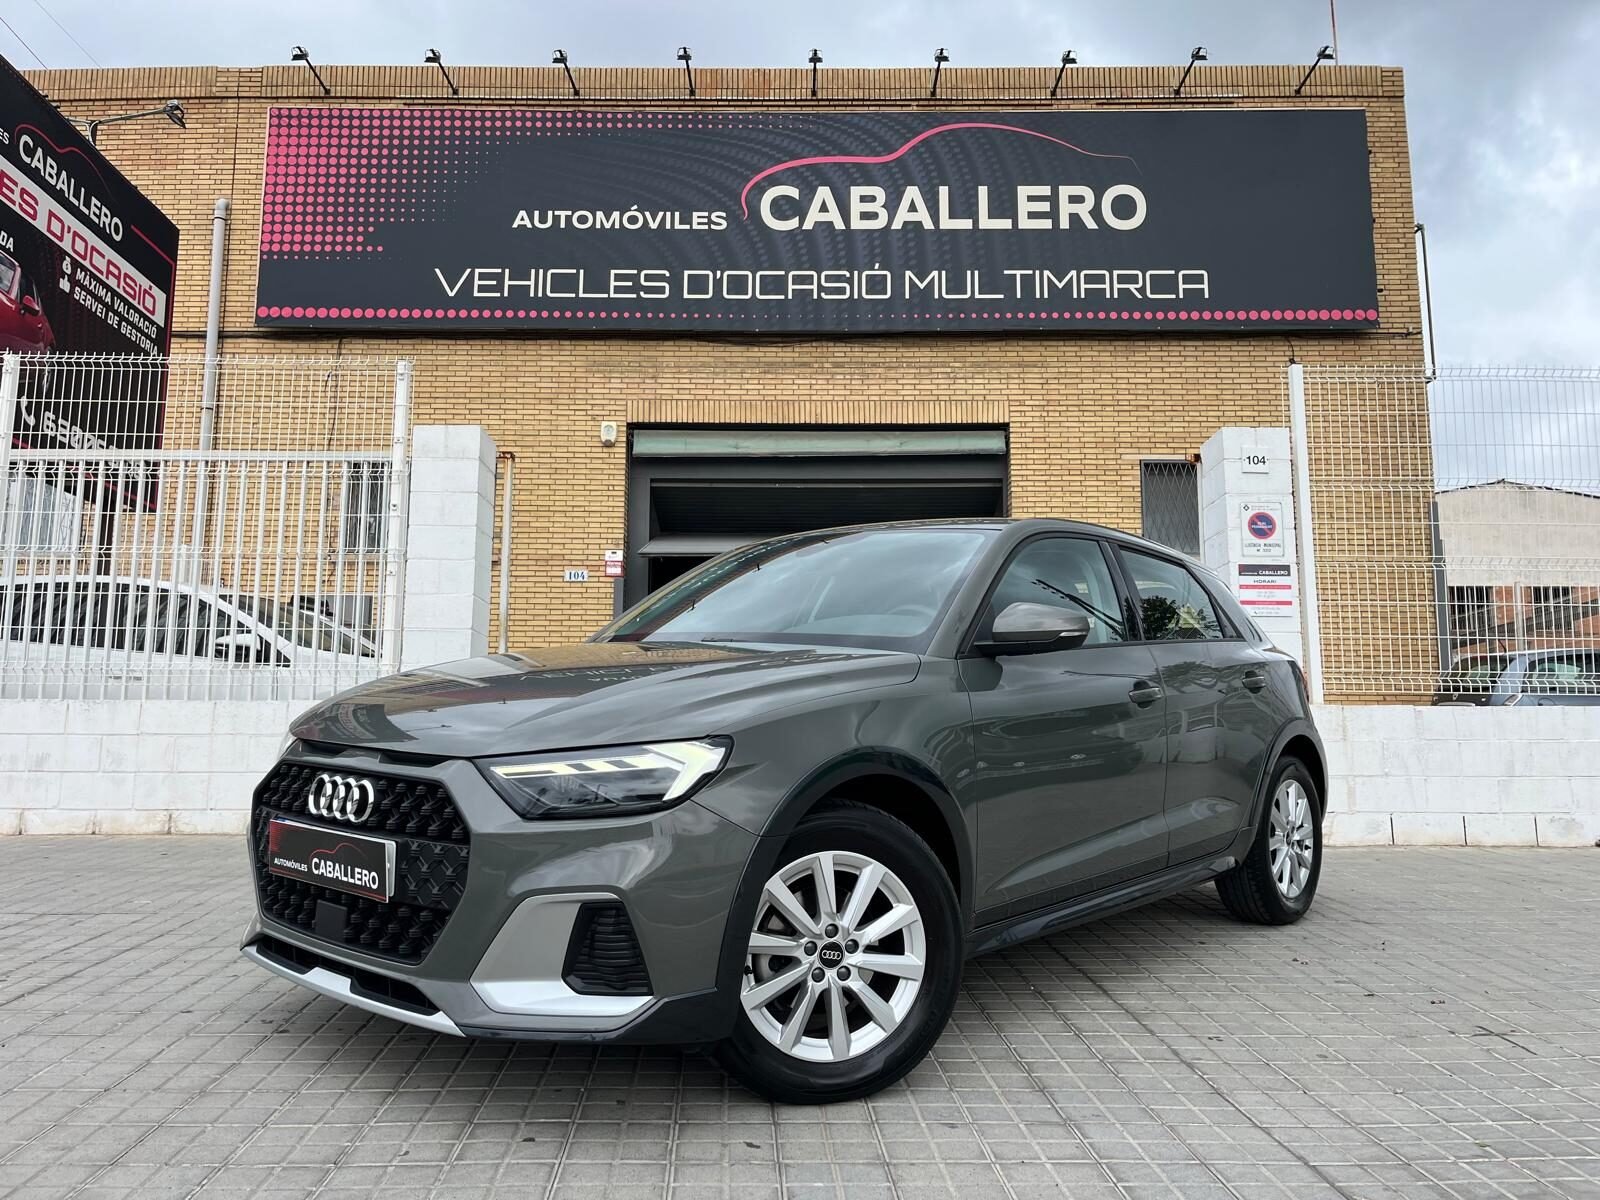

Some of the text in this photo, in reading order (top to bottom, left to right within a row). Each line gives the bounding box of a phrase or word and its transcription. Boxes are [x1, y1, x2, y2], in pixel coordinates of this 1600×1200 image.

[19, 134, 123, 242] CABALLERO
[512, 184, 1147, 231] AUTOMÓVILES CABALLERO
[47, 208, 157, 317] D'OCASIÓ
[434, 262, 1210, 300] VEHICLES D'OCASIÓ MULTIMARCA
[73, 286, 106, 320] SERVEI
[107, 311, 120, 329] DE
[114, 296, 158, 339] VALORACIÓ
[1245, 455, 1266, 465] 104
[569, 571, 585, 580] 104
[274, 857, 379, 889] AUTOMÓVILES CABALLERO
